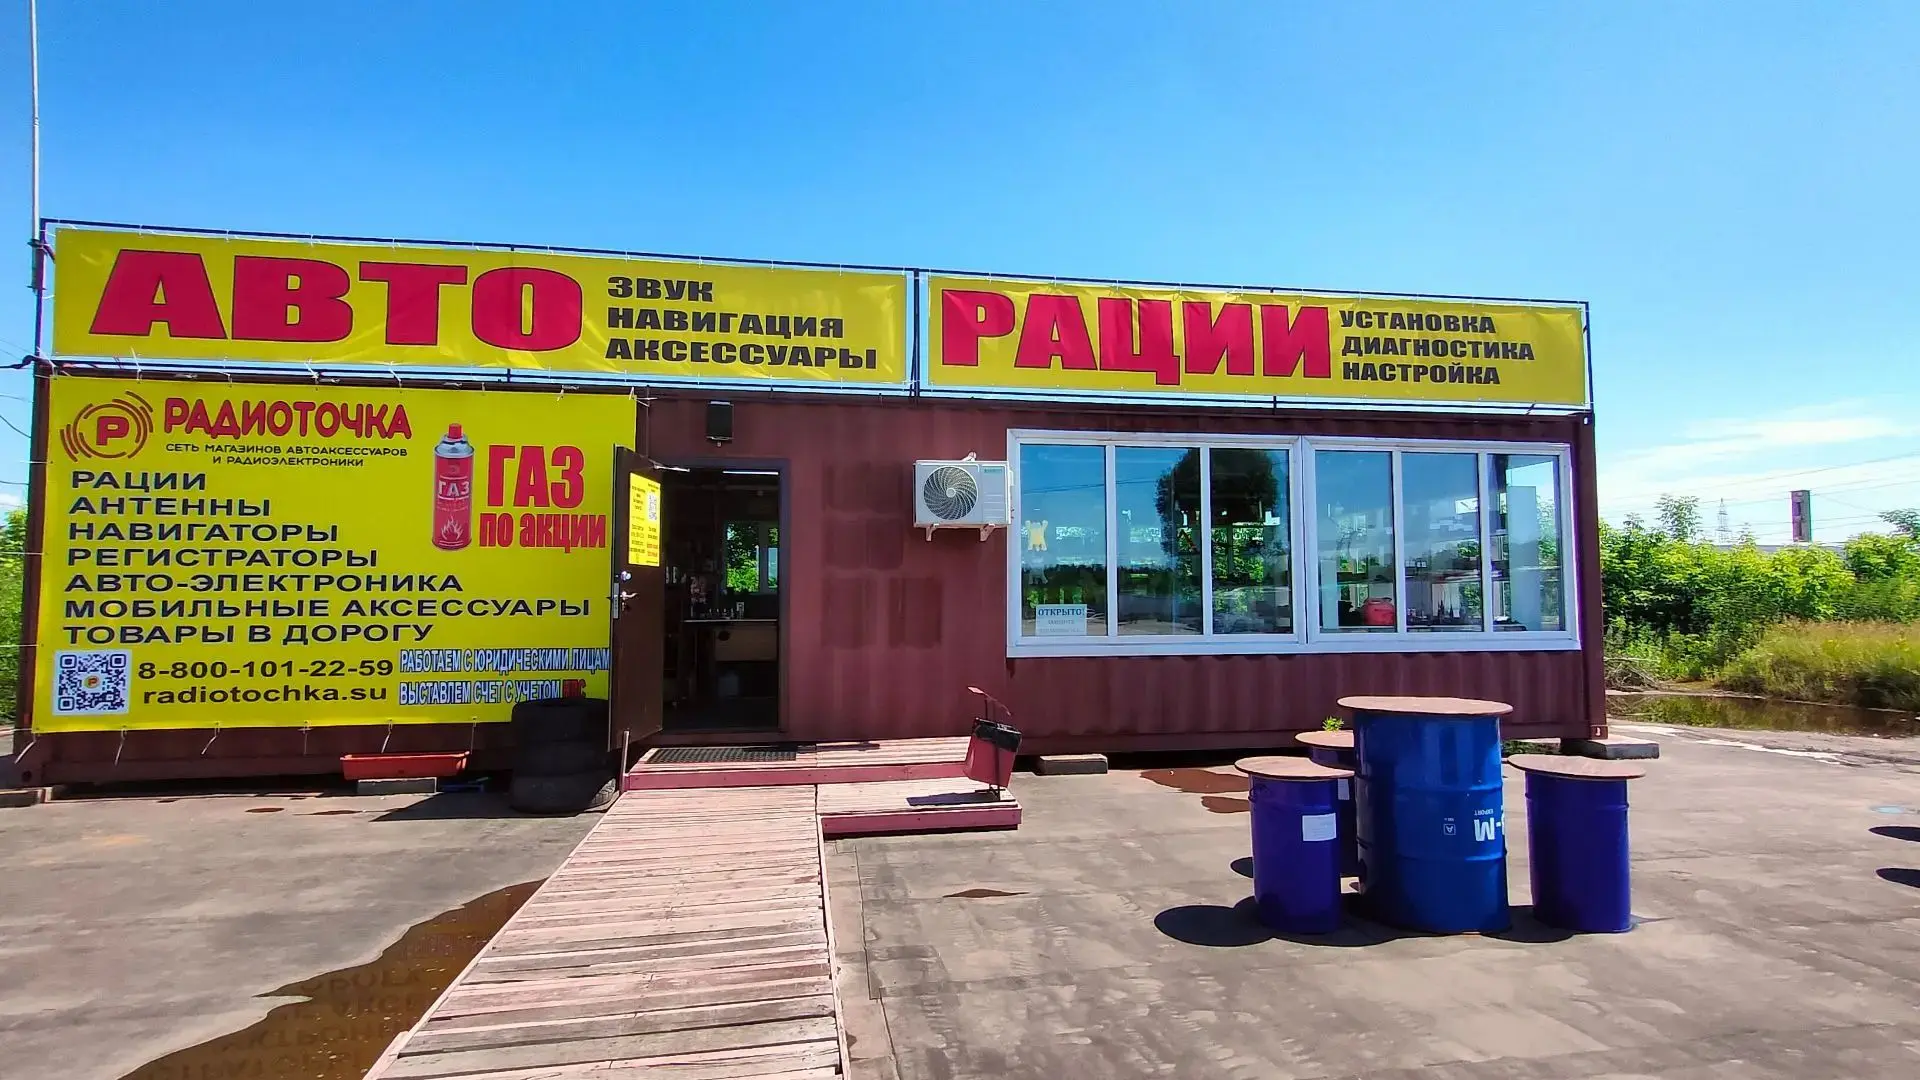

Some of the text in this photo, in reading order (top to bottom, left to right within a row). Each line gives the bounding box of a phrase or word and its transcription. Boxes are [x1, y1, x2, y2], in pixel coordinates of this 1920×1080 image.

[89, 248, 583, 351] АВТО
[607, 276, 714, 302] ЗВУК
[607, 307, 844, 339] НАВИГАЦИЯ
[1340, 310, 1496, 334] УСТАНОВКА
[941, 288, 1331, 386] РАЦИИ
[1341, 336, 1535, 361] ДИАГНОСТИКА
[605, 338, 877, 370] АКСЕССУАРЫ
[1342, 362, 1500, 385] НАСТРОЙКА
[164, 397, 412, 440] РАДИОТОЧКА
[166, 443, 408, 457] СЕТЬ МАГАЗИНОВ АВТОАКСЕССУАРОВ
[213, 456, 364, 467] И РАДИОЭЛЕКТРОНИКИ
[72, 470, 206, 493] РАЦИИ
[487, 444, 585, 509] ГАЗ
[438, 480, 469, 497] ГАЗ
[69, 496, 271, 517] АНТЕННЫ
[68, 522, 338, 543] НАВИГАТОРЫ
[68, 548, 377, 568] РЕГИСТРАТОРЫ
[64, 573, 463, 594] АВТО-ЭЛЕКТРОНИКА
[64, 599, 591, 619] МОБИЛЬНЫЕ АКСЕССУАРЫ
[63, 624, 433, 646] ТОВАРЫ В ДОРОГУ
[138, 659, 394, 680] 8-800-101-22-59
[400, 648, 610, 675] РАБОТАЕМ С ЮРИДИЧЕСКИМИ ЛИЦАМ
[143, 684, 387, 705] radiotochka.su
[400, 681, 472, 705] ВЫСТАВЛЕМ
[473, 680, 504, 704] СЧЕТ
[505, 680, 514, 703] С
[515, 679, 561, 703] УЧЕТОМ
